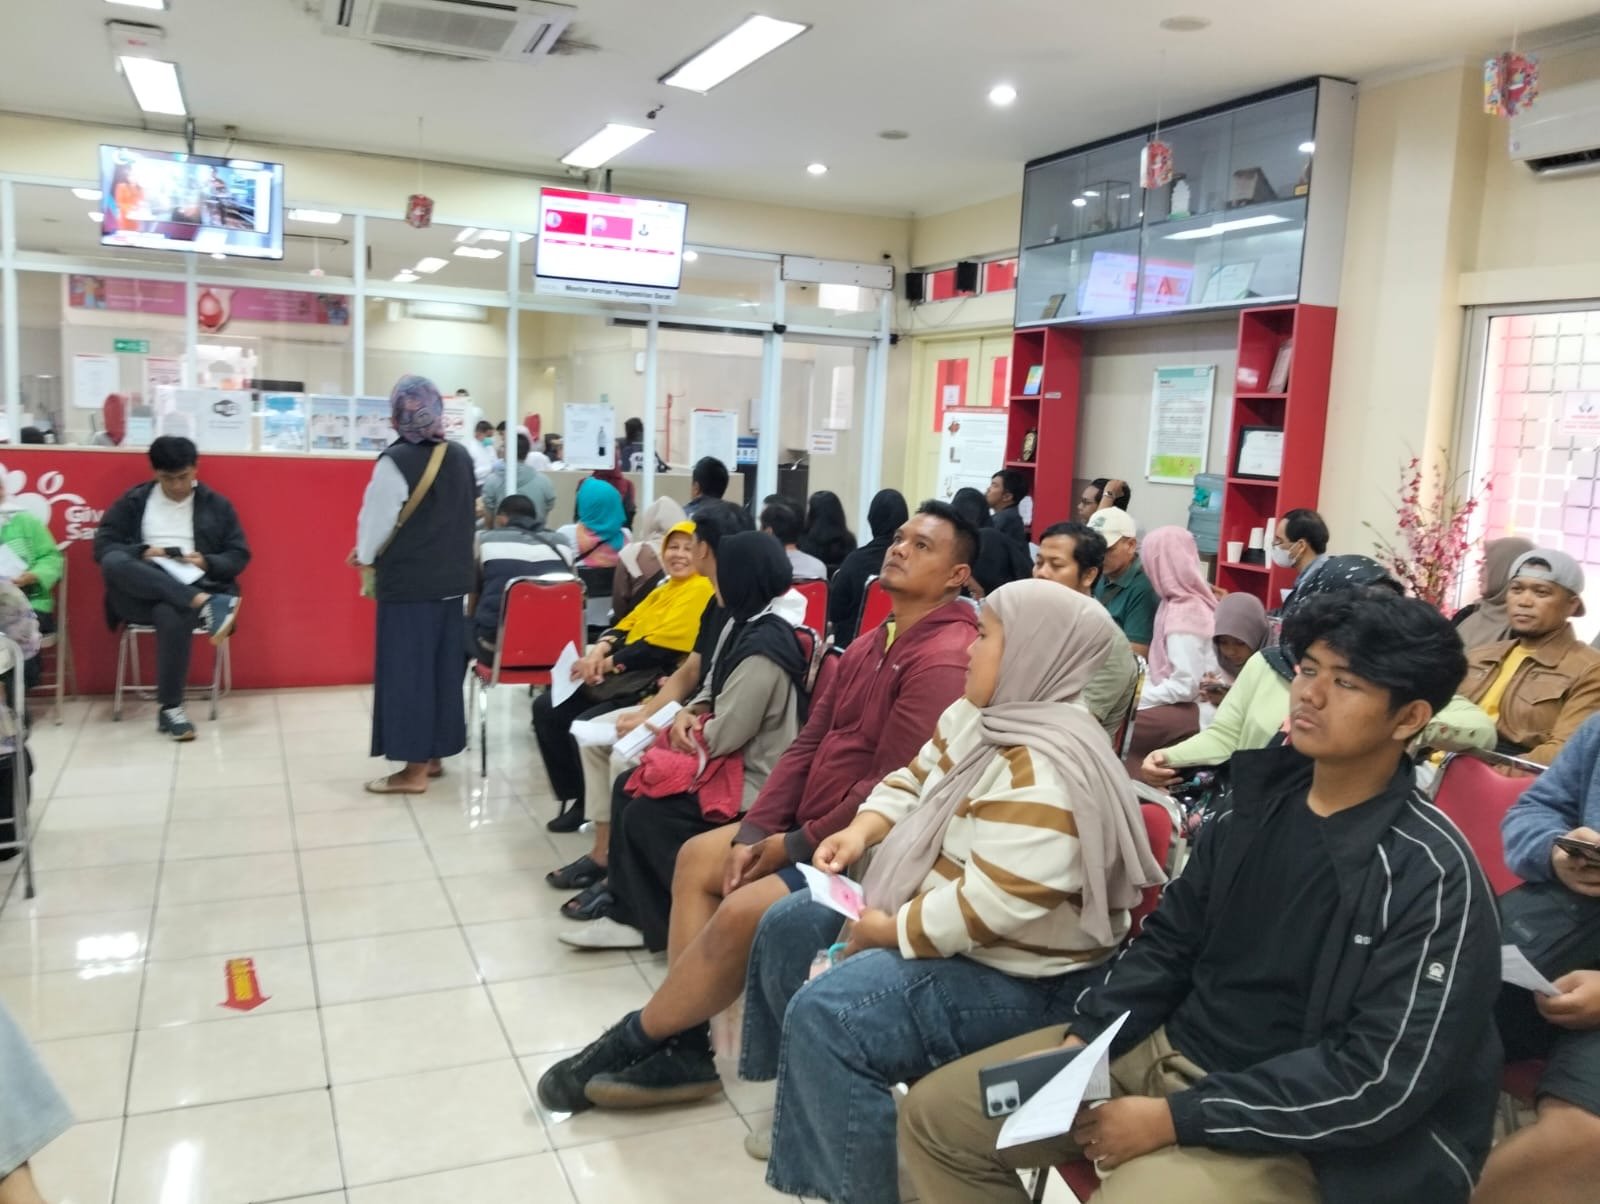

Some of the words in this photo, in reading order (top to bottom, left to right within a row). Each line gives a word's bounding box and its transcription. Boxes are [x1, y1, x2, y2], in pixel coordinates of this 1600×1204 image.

[565, 285, 588, 293] Monitor
[65, 506, 105, 523] Giv
[66, 523, 98, 540] Sa
